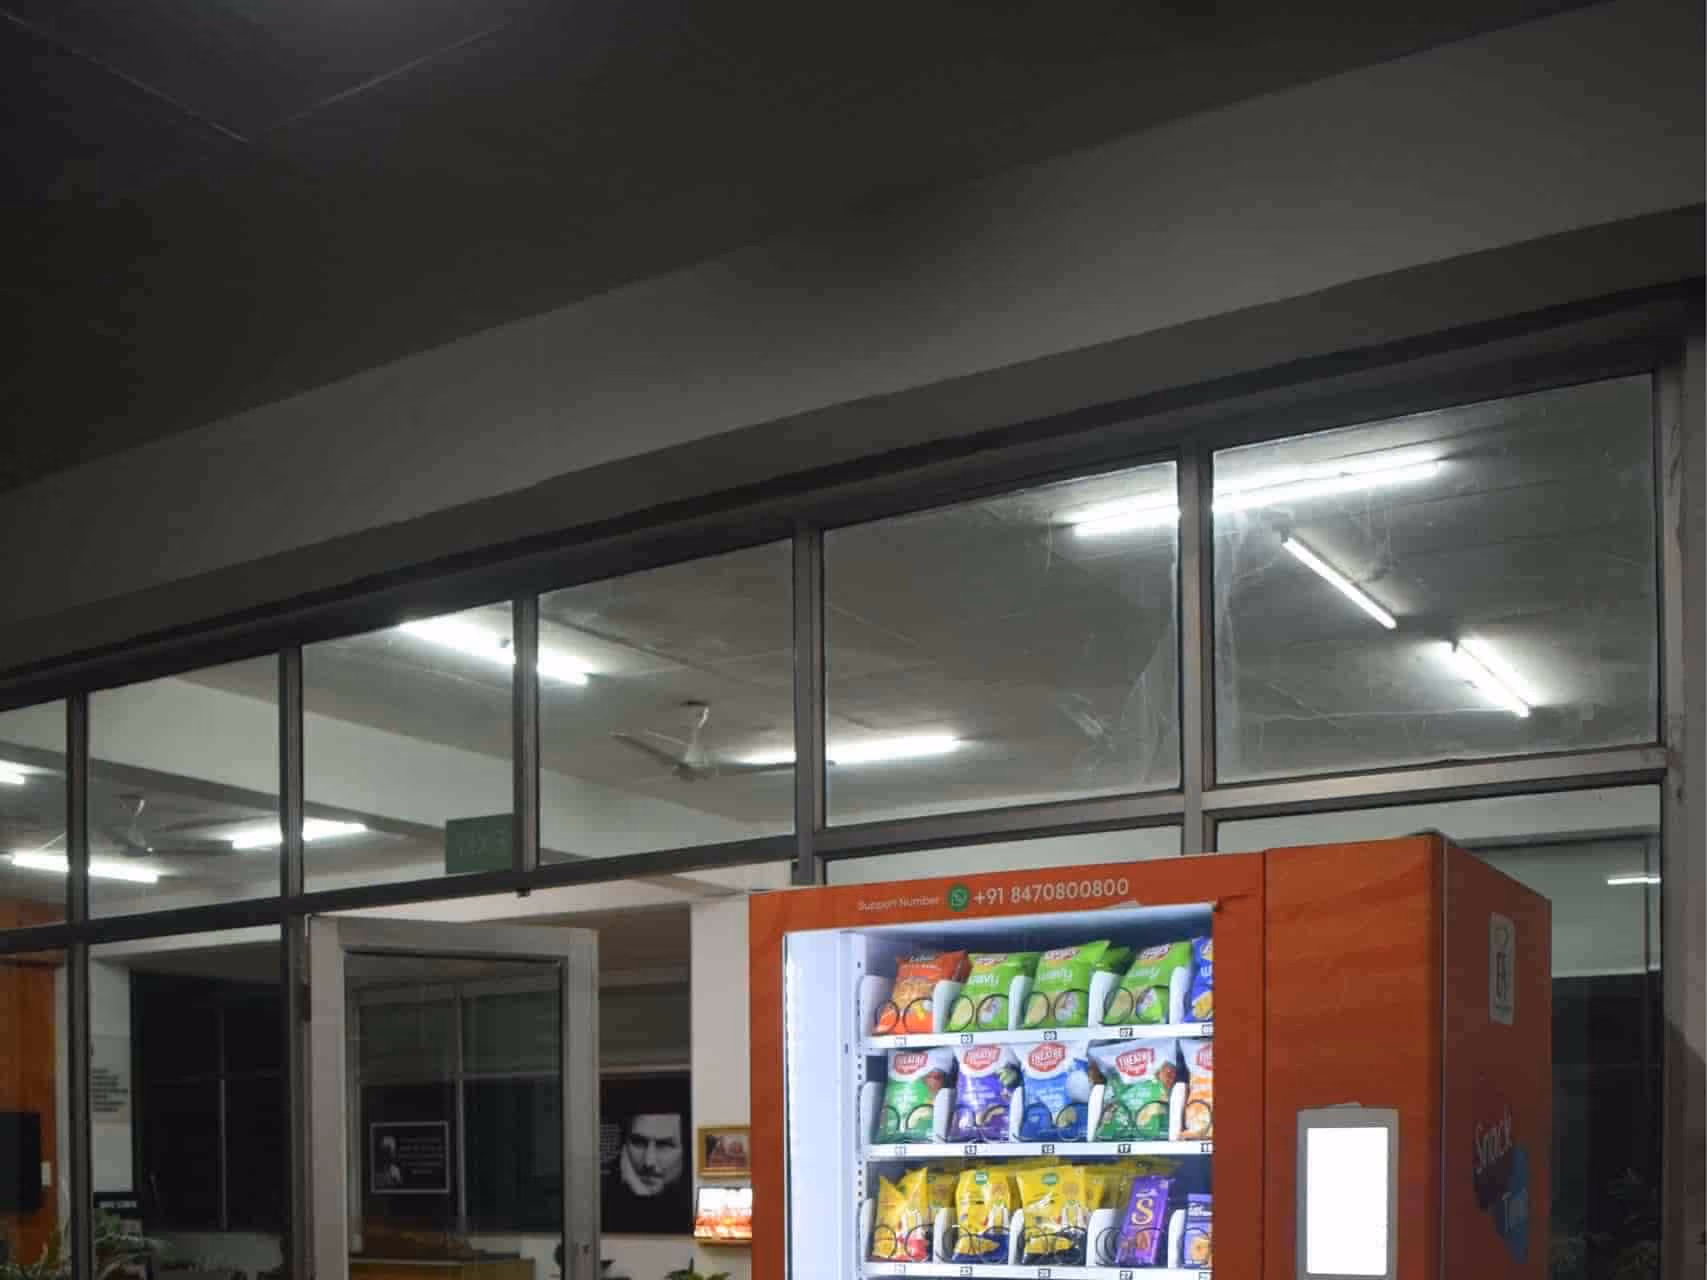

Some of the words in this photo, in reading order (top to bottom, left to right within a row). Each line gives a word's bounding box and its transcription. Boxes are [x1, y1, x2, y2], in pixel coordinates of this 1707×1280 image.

[857, 899, 897, 912] Support
[899, 895, 939, 908] Number
[975, 887, 1005, 905] +91
[1011, 878, 1129, 904] 8470800800
